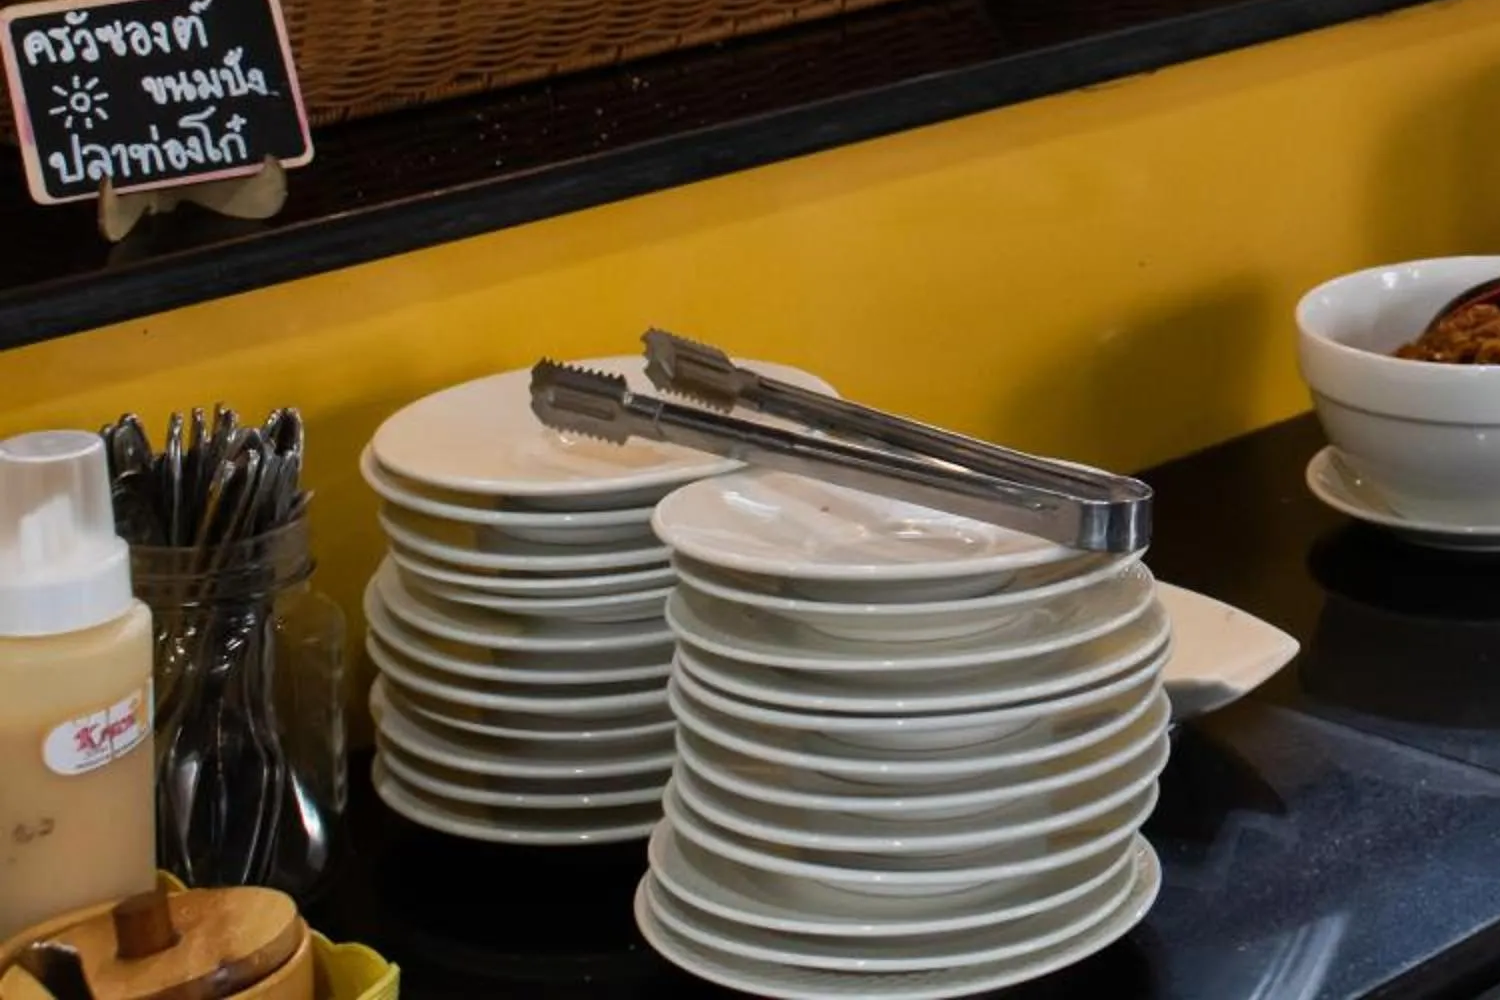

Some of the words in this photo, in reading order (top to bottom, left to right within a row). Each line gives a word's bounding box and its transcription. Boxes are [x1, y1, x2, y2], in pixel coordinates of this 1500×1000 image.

[141, 45, 271, 105] ขนมปัง
[48, 105, 248, 185] ปลาท่องโก๋
